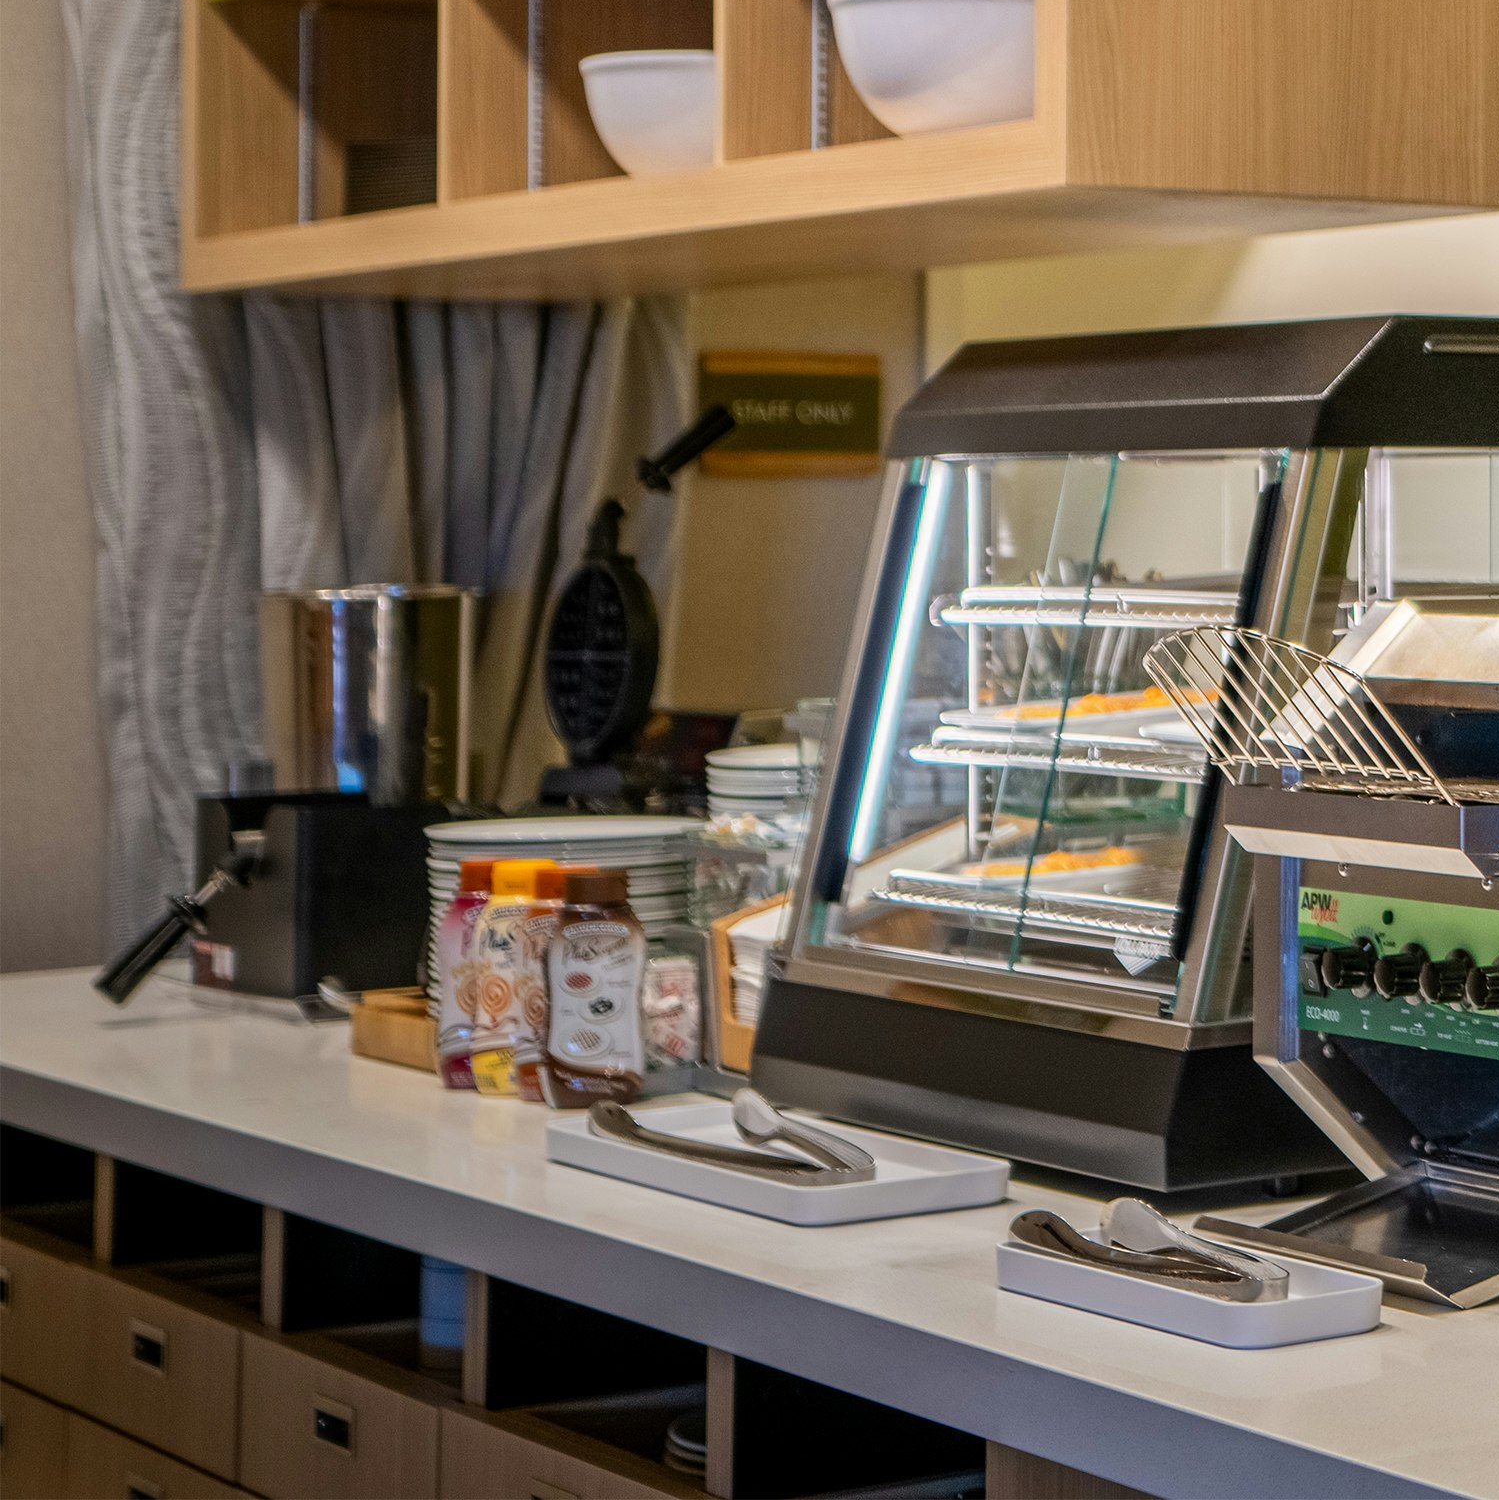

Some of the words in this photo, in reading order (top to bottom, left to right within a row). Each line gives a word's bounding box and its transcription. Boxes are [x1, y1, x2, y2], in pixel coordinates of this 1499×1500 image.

[795, 401, 853, 425] ONLY
[1301, 892, 1331, 910] APW
[1306, 1005, 1340, 1022] ECO-4000
